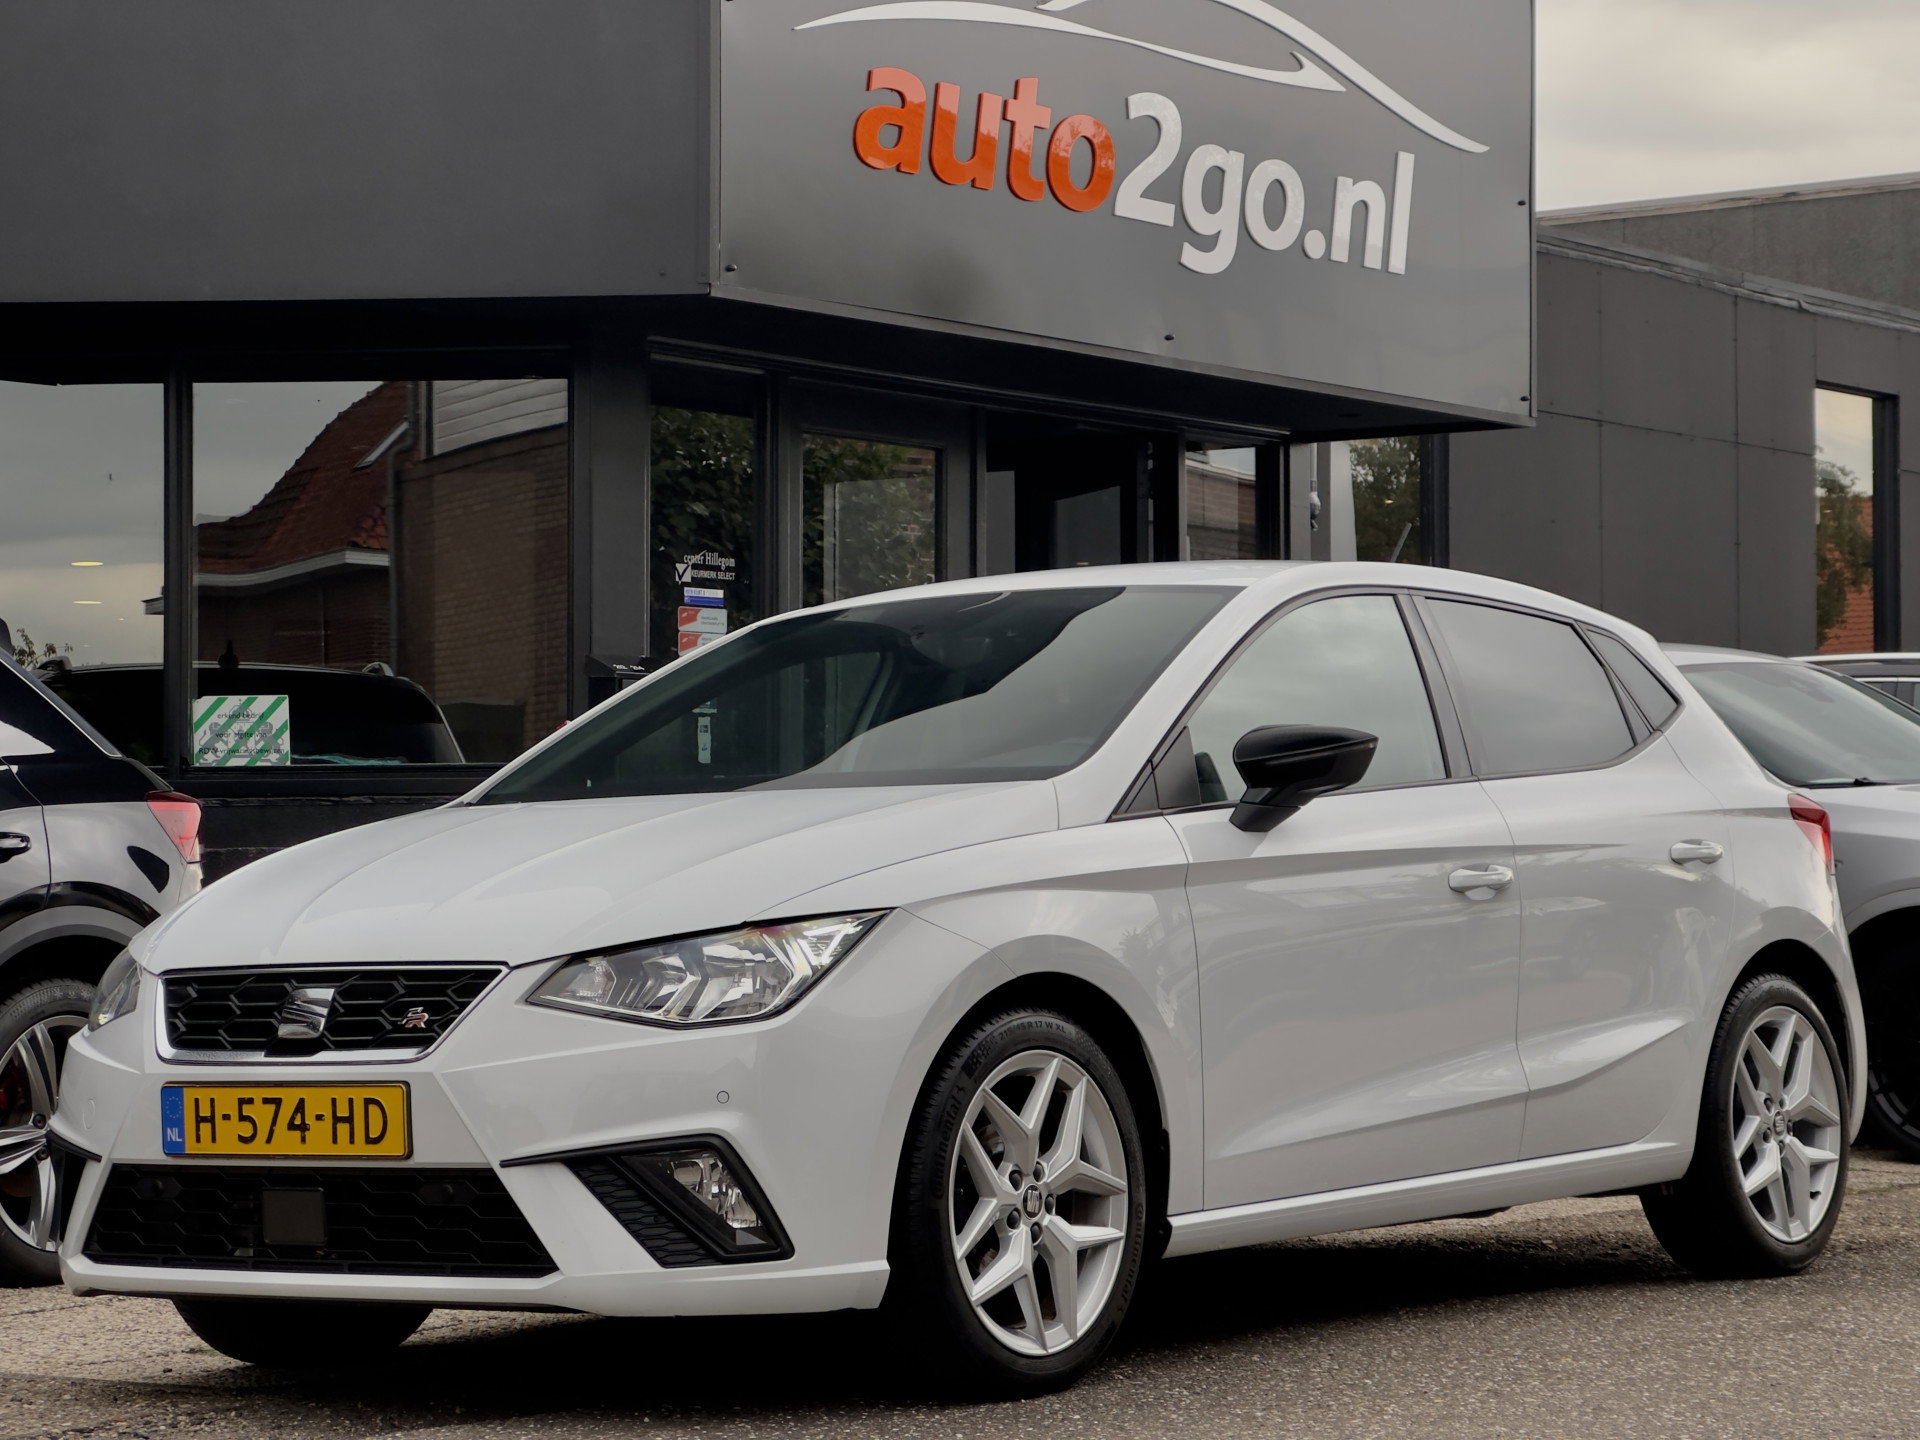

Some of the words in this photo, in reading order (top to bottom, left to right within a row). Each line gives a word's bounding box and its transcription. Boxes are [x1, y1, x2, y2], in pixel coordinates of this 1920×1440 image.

[853, 66, 1415, 274] auto2go.nl
[705, 552, 735, 570] Hillegom
[691, 570, 717, 579] KEURMERK
[717, 571, 736, 580] SELECT
[1035, 1020, 1043, 1029] 17
[1055, 1023, 1067, 1034] XL
[193, 1096, 388, 1146] H-574-HD
[167, 1127, 183, 1142] NL
